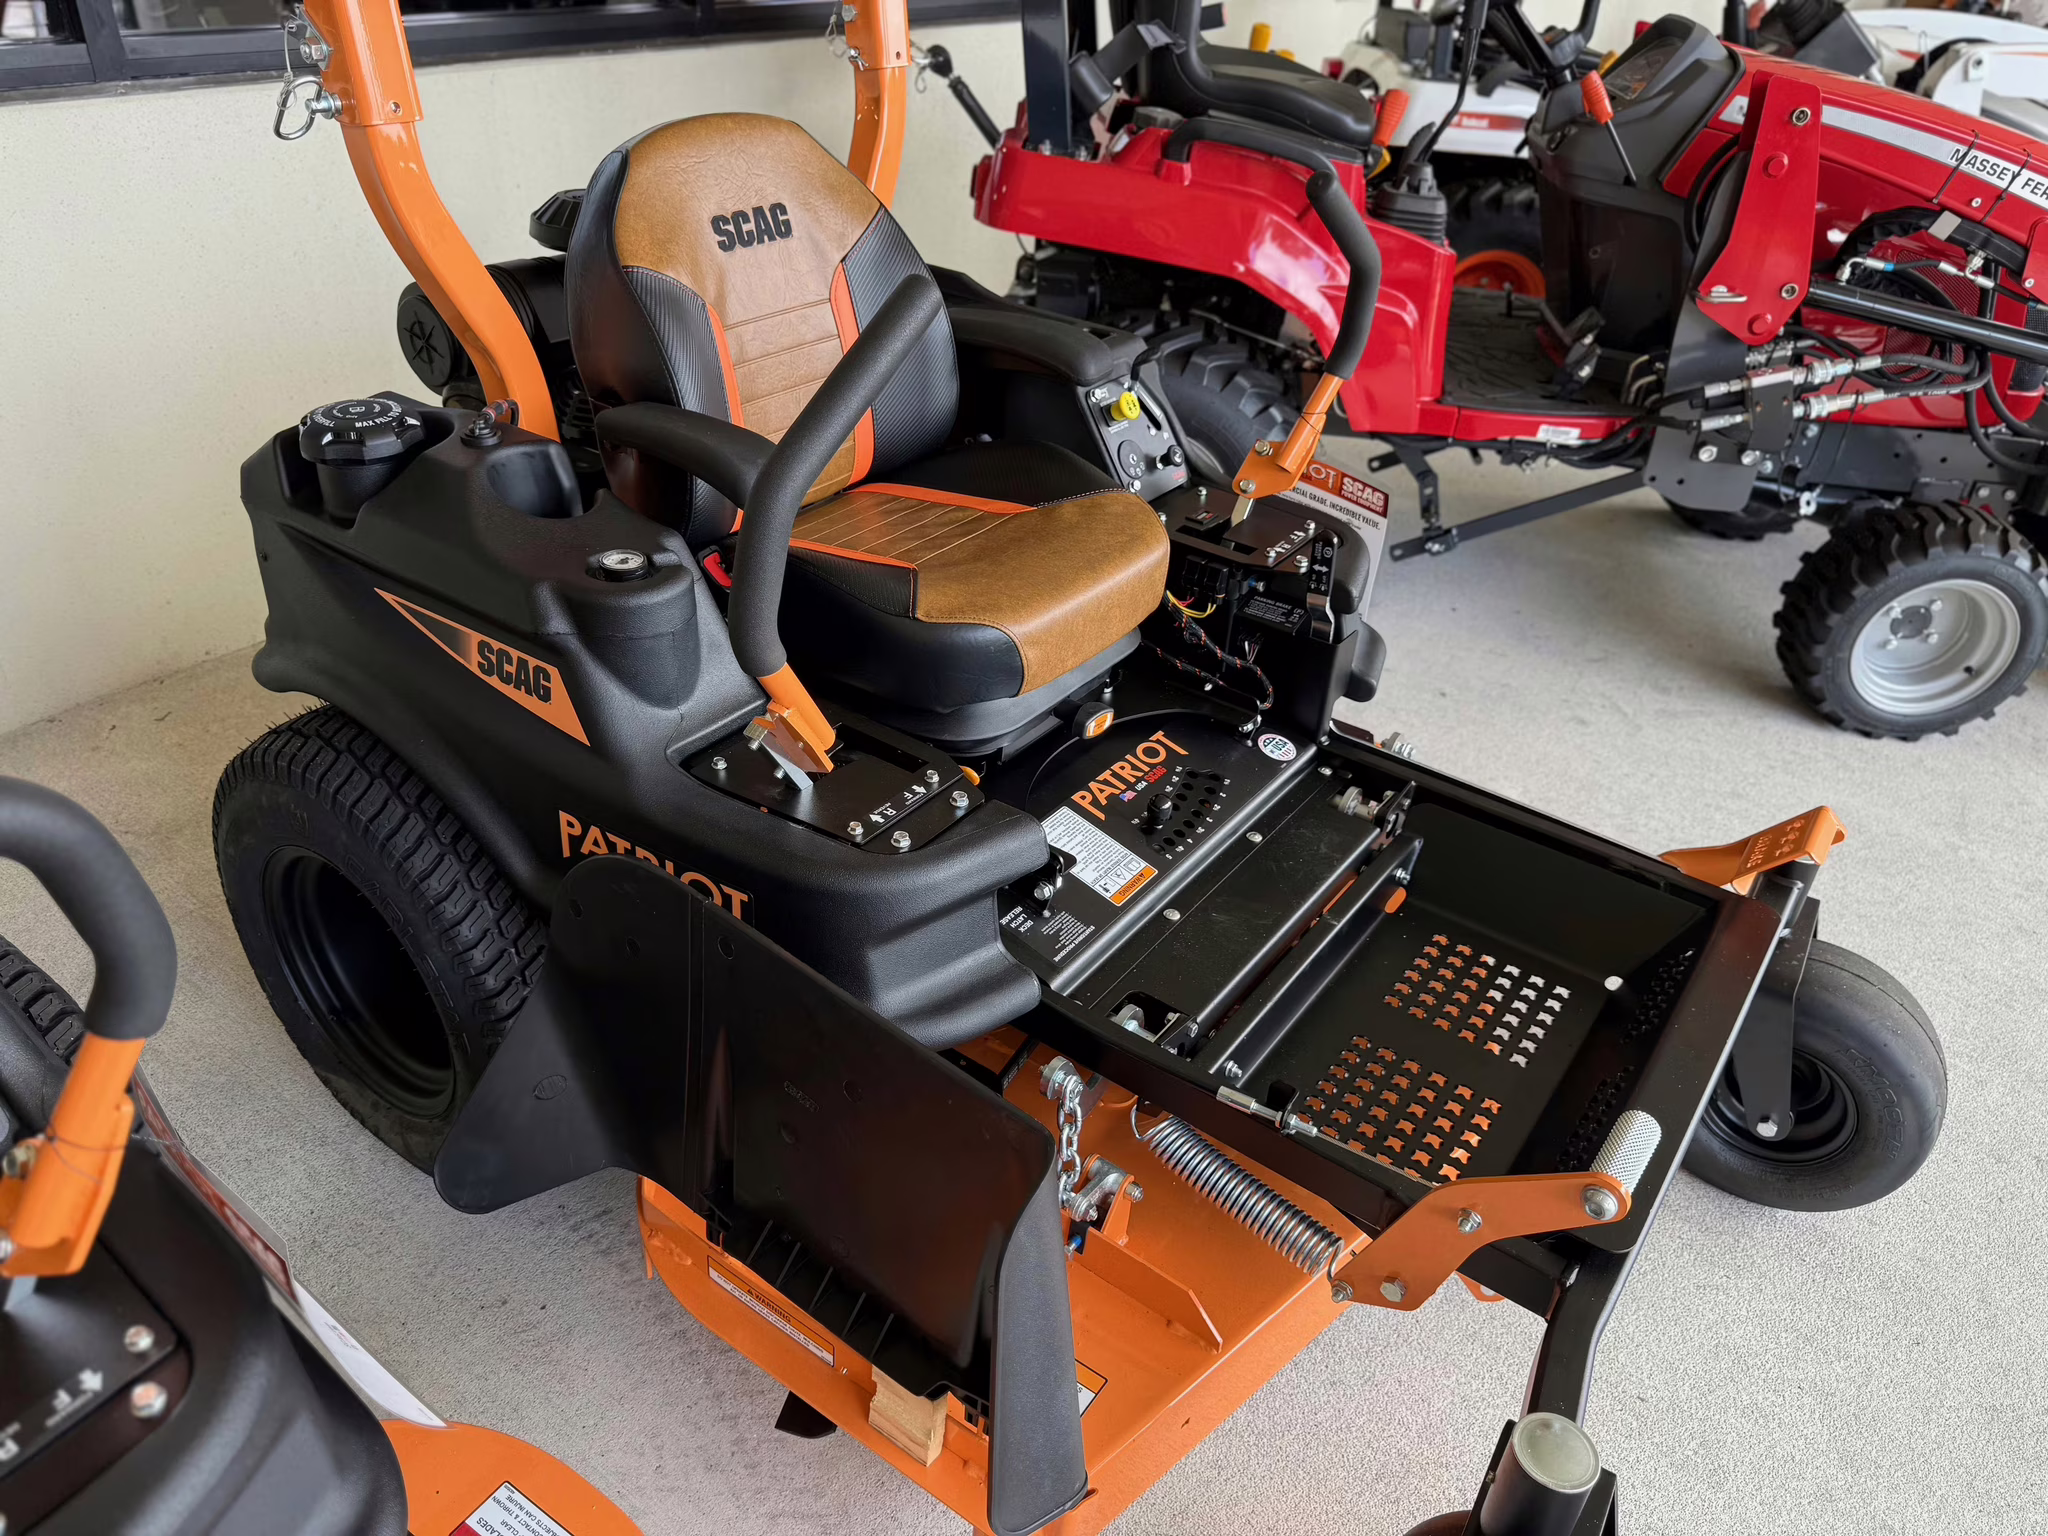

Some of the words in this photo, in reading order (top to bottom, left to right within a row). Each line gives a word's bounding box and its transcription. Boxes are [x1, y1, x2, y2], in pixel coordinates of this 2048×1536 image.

[1949, 148, 2022, 183] MASSEY
[710, 202, 792, 253] SCAG
[1342, 477, 1385, 507] SCAG
[1328, 502, 1361, 521] INCREDIBLE
[1361, 516, 1381, 531] VALUE.
[477, 640, 552, 704] SCAG
[1071, 730, 1189, 821] PATRIOT
[1135, 780, 1149, 791] USA
[1144, 765, 1168, 784] SCAG
[903, 791, 914, 800] F
[883, 807, 897, 816] R
[1118, 875, 1141, 897] WARNING
[999, 905, 1023, 926] RELEASE
[1010, 913, 1028, 929] LATCH
[1018, 919, 1035, 933] DECK
[753, 1292, 792, 1323] WARNING
[491, 1495, 516, 1517] THROWN
[505, 1494, 526, 1512] INJURE
[476, 1516, 505, 1536] LADES
[524, 1509, 537, 1522] CAN
[500, 1518, 520, 1536] CLEAR
